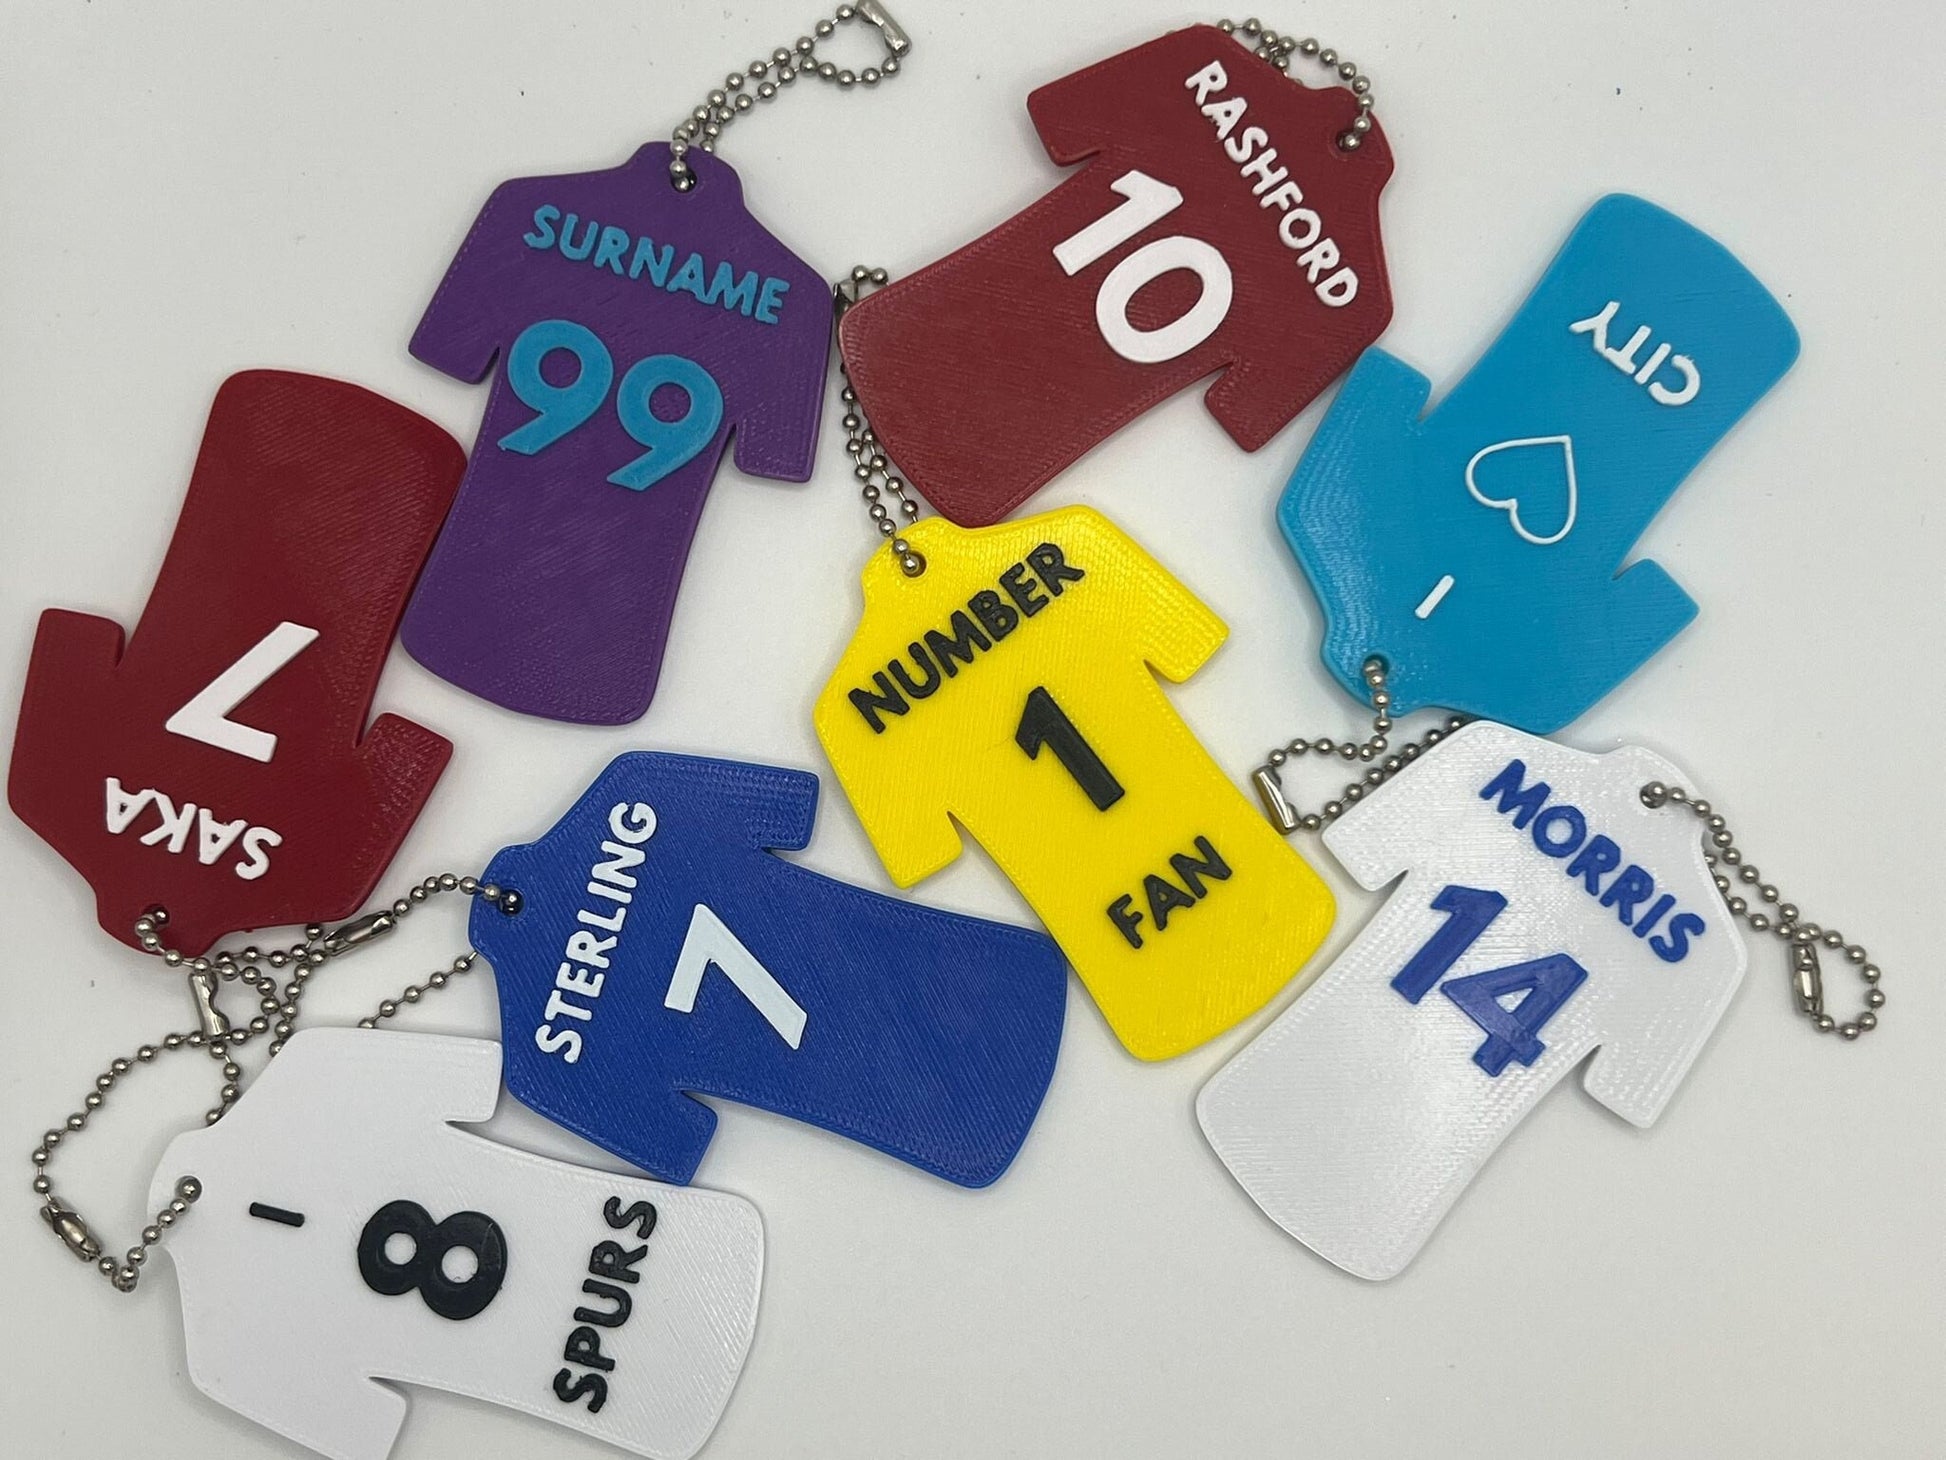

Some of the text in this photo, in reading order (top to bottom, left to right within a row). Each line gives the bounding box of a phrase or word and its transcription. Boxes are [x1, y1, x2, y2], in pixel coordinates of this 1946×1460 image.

[1184, 60, 1359, 308] RASHFORD
[523, 204, 789, 325] SURNAME
[1053, 170, 1233, 364] 10
[497, 320, 724, 489] 99
[1570, 301, 1700, 406] CITY
[848, 542, 1085, 734] NUMBER
[1415, 574, 1453, 618] I
[166, 621, 319, 762] 7
[1015, 686, 1124, 811] 1
[105, 777, 283, 879] SAKA
[1106, 835, 1232, 948] FAN
[1479, 758, 1706, 962] MORRIS
[536, 801, 657, 1062] STERLING
[664, 903, 807, 1050] 7
[1390, 885, 1588, 1076] 14
[249, 1201, 304, 1227] I
[357, 1199, 507, 1319] 8
[553, 1196, 658, 1412] SPURS
